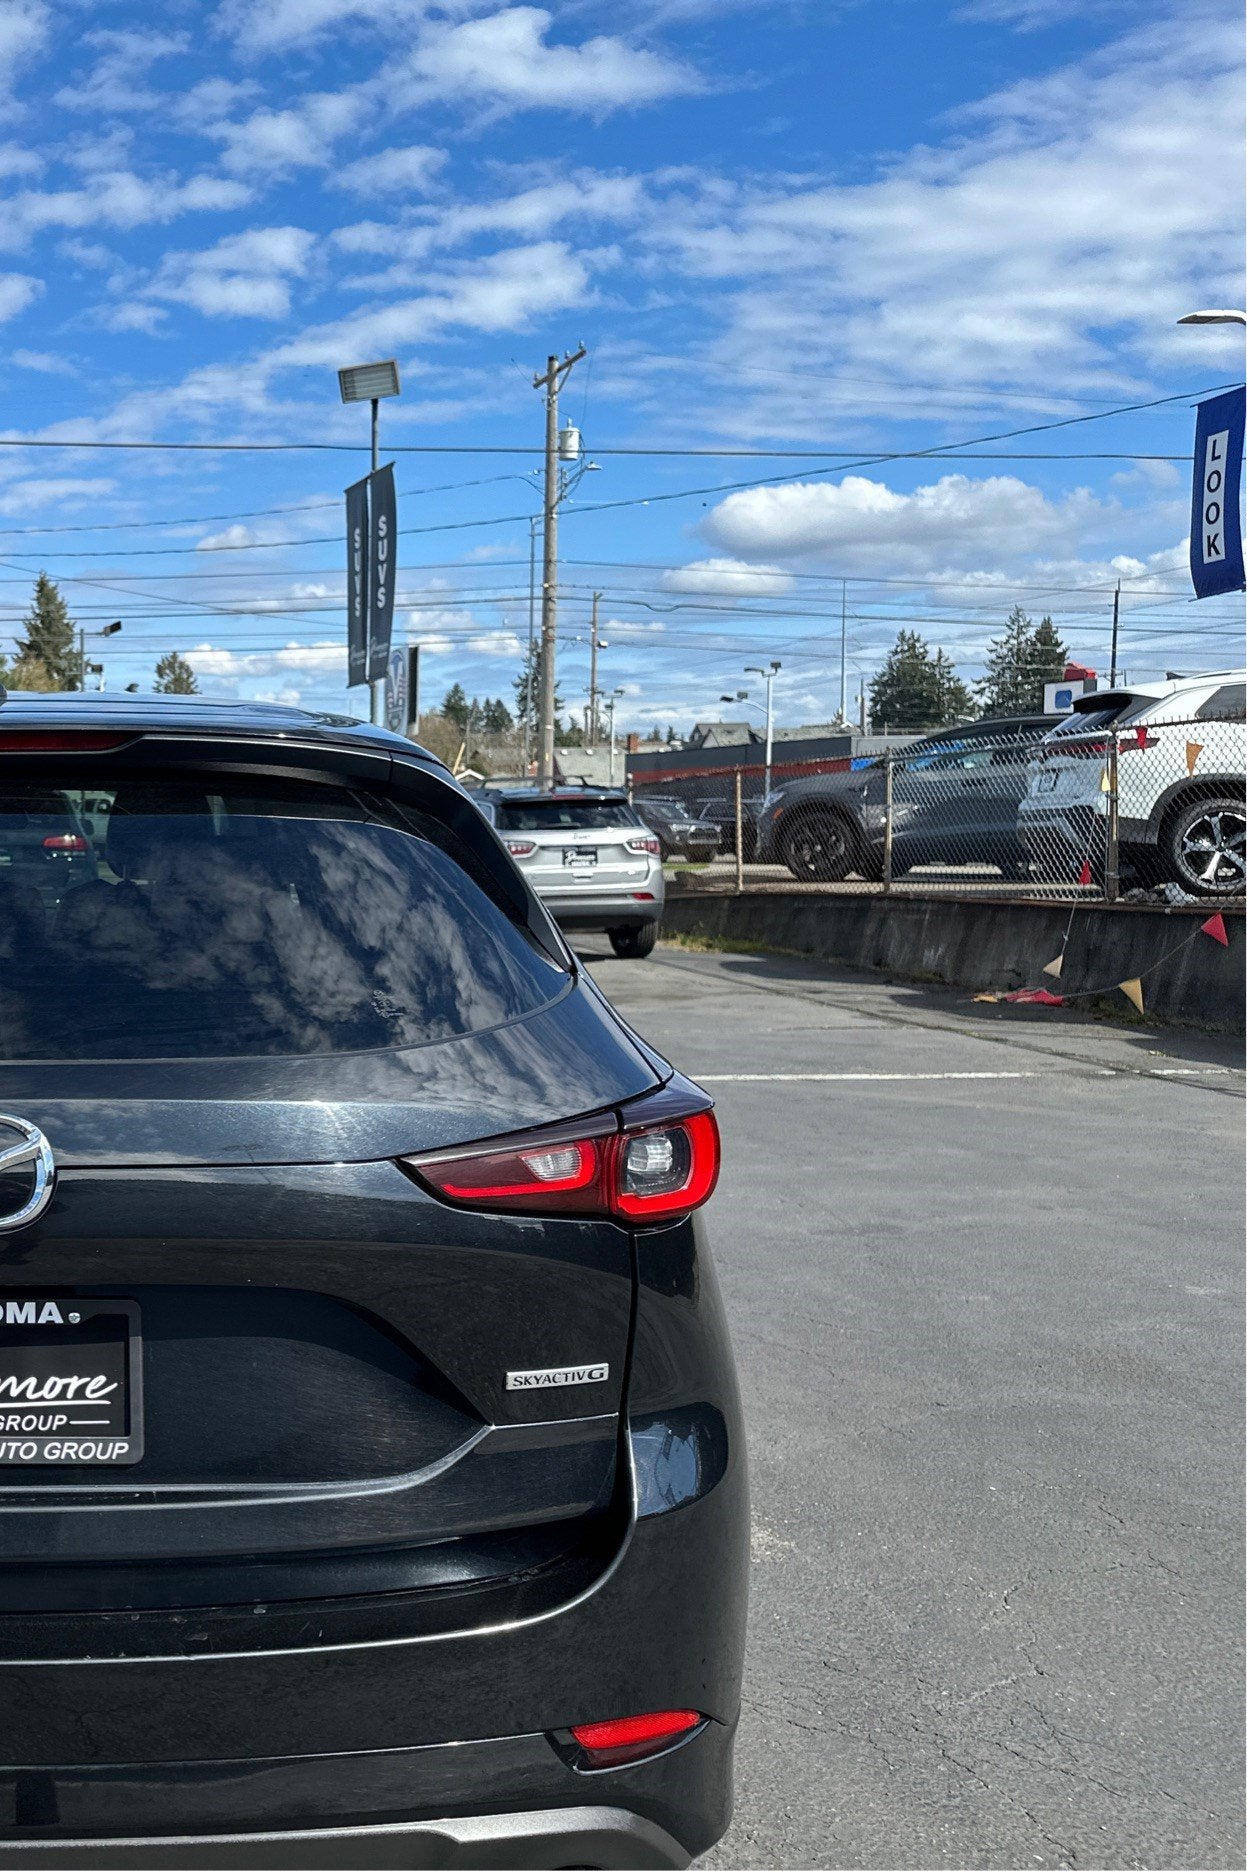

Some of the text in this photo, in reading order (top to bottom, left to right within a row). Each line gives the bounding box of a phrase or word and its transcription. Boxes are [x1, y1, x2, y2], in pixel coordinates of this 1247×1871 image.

[1205, 439, 1222, 558] LOOK
[377, 515, 387, 609] SUVS
[43, 1442, 129, 1460] GROUP
